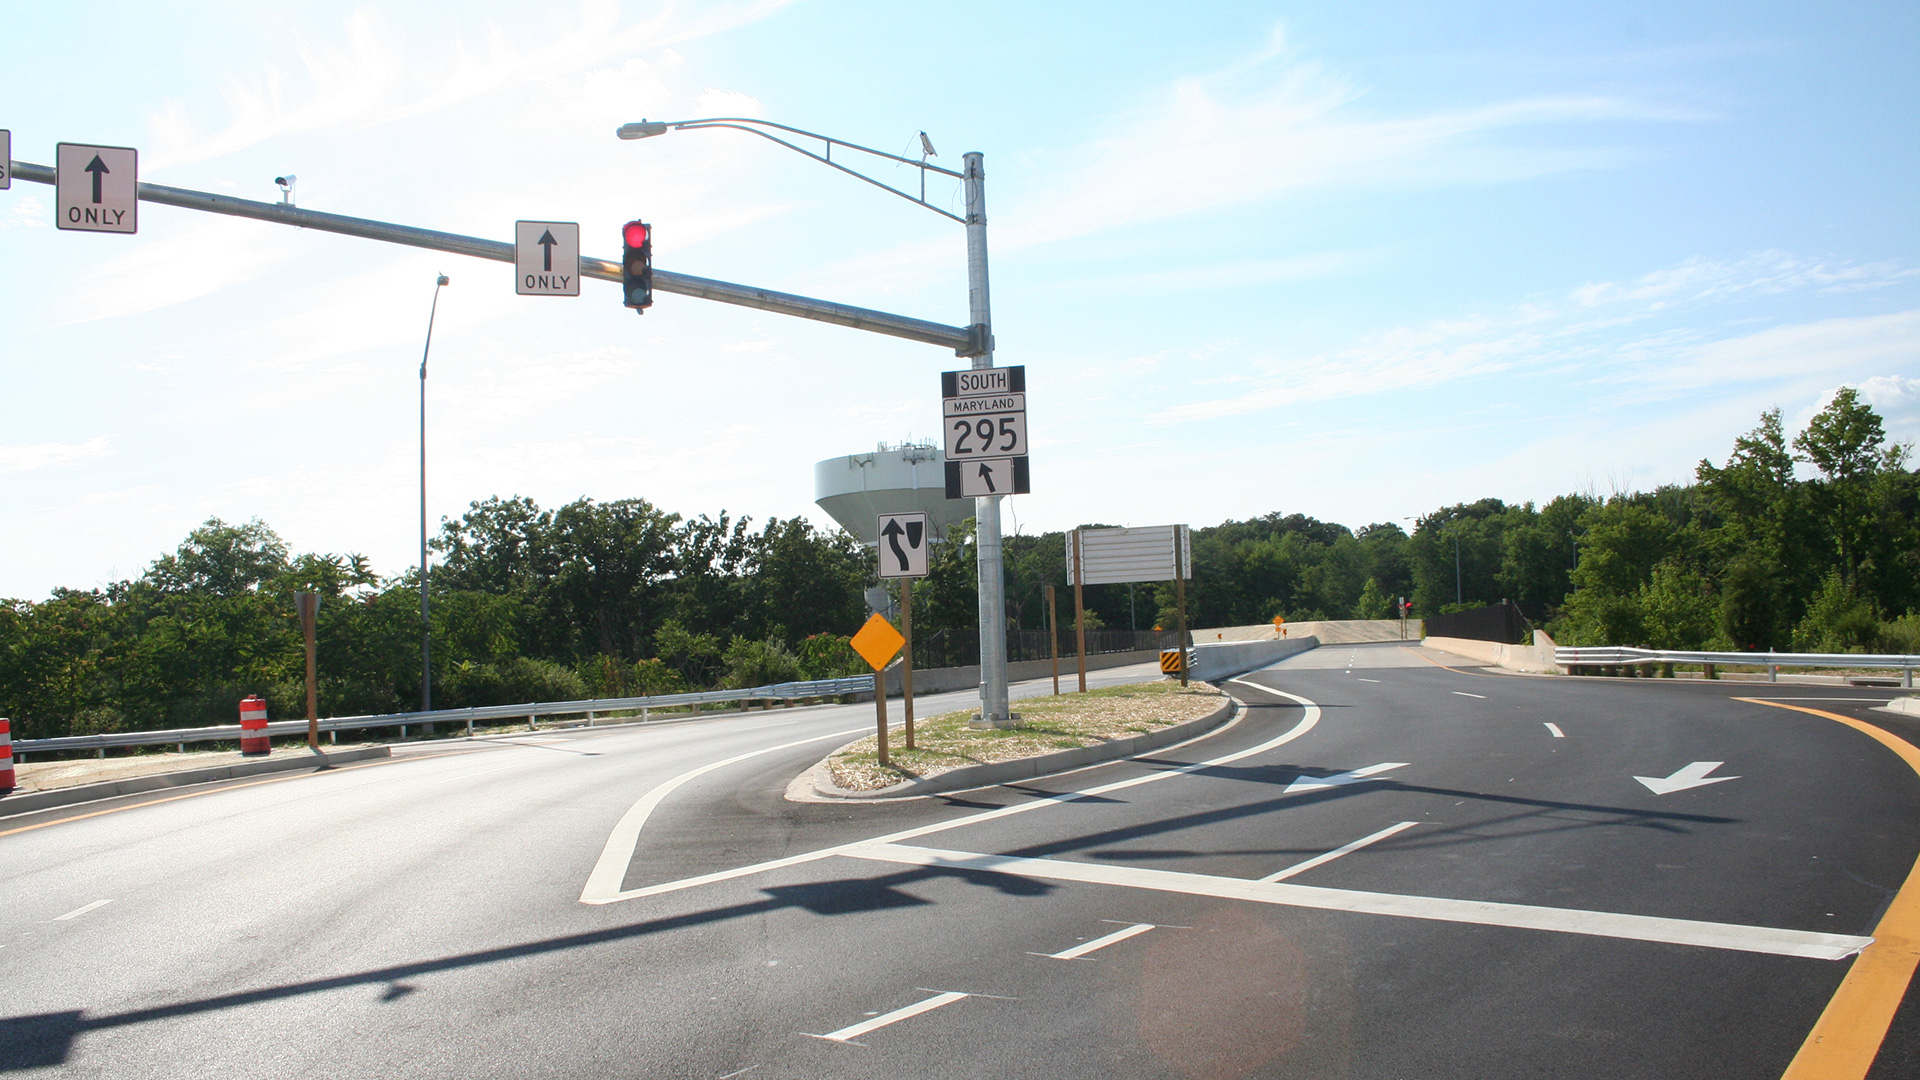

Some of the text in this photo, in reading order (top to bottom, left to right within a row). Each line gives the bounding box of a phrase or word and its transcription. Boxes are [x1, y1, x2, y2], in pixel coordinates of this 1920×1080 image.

[68, 206, 126, 225] ONLY
[525, 274, 571, 290] ONLY
[960, 372, 1006, 391] SOUTH
[953, 398, 1014, 412] MARYLAND
[953, 417, 1017, 454] 295
